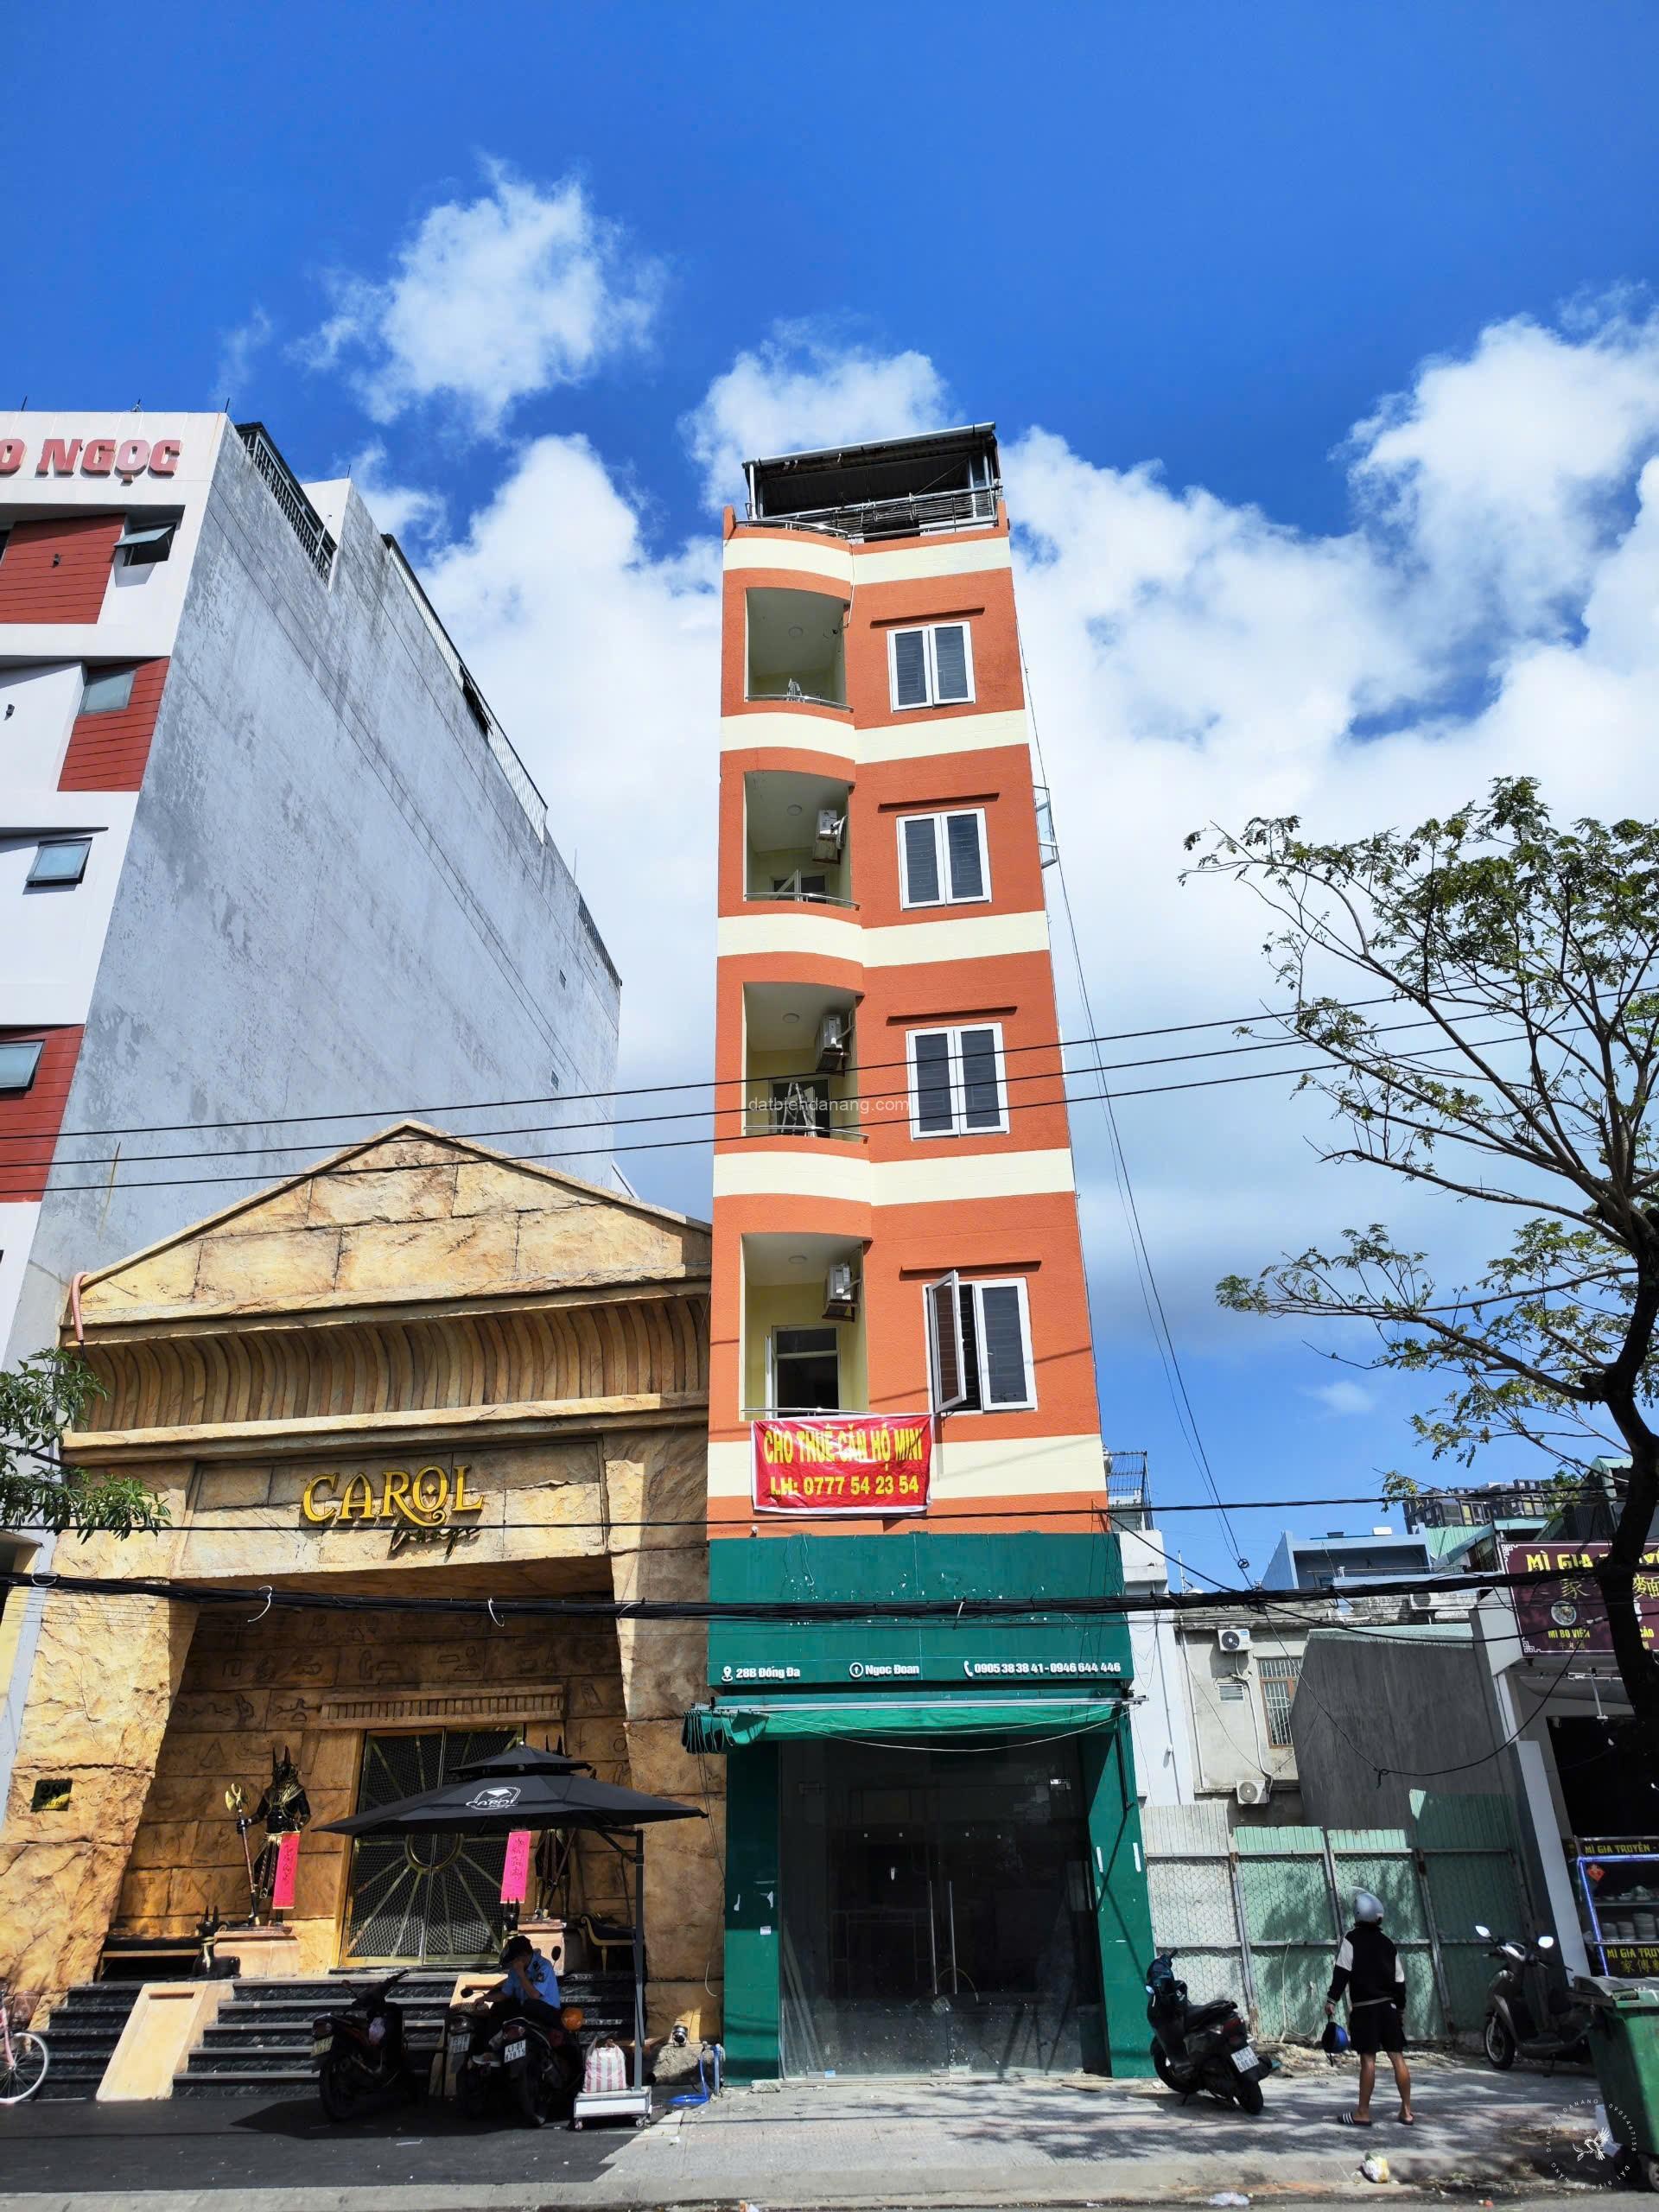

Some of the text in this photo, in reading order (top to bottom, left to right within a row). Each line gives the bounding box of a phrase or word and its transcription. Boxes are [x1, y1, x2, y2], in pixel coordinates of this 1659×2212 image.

[36, 438, 181, 484] NGỌC
[764, 1430, 793, 1464] CHO
[797, 1425, 834, 1463] THUÊ
[871, 1422, 891, 1471] HỘ
[804, 1476, 844, 1495] 0777
[850, 1476, 870, 1495] 54
[875, 1475, 893, 1495] 23
[899, 1475, 919, 1494] 54
[302, 1465, 485, 1528] CAROL
[1526, 1550, 1551, 1572] MÌ
[786, 1667, 801, 1677] Đa
[974, 1663, 1001, 1674] 0905
[1001, 1663, 1015, 1674] 38
[1016, 1662, 1029, 1673] 38
[1031, 1662, 1044, 1674] 41
[1050, 1662, 1077, 1673] 0946
[1597, 1845, 1613, 1853] GIA
